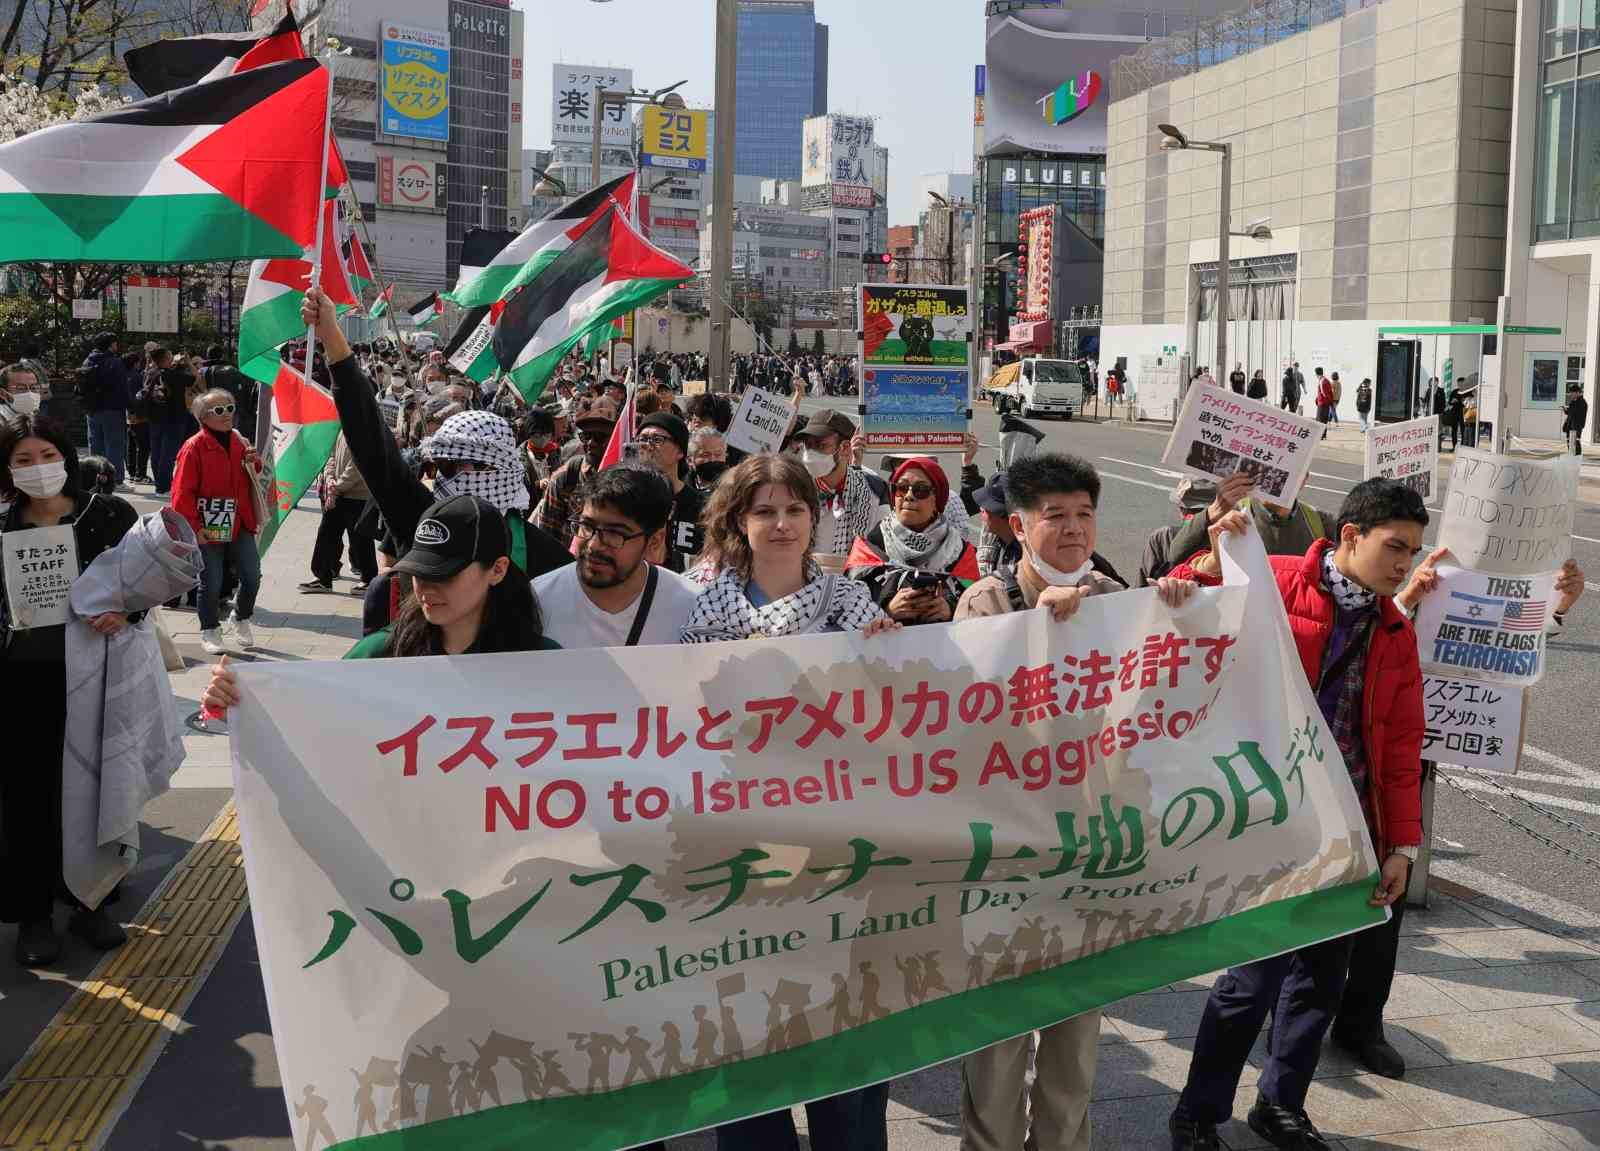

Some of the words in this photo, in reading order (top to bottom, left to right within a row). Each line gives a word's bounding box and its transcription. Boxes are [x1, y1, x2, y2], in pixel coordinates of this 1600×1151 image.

[832, 117, 873, 145] カラオケ
[836, 159, 869, 182] 鉄人
[895, 289, 937, 298] イスラエルは
[867, 297, 967, 316] ガザから撤退しろ
[745, 408, 772, 431] Land
[1199, 410, 1297, 453] 直ちにイラン攻撃を
[908, 434, 926, 443] with
[927, 433, 962, 443] Palestine
[21, 559, 65, 573] STAFF
[1486, 577, 1532, 599] THESE
[1437, 623, 1466, 642] ARE
[1468, 627, 1494, 646] THE
[1495, 631, 1537, 651] FLAGS
[376, 632, 1237, 776] イスラエルとアメリカの無法を許す
[1422, 728, 1503, 756] テロ国家
[485, 779, 587, 832] NO
[607, 781, 671, 823] to
[599, 928, 807, 1002] Palestine
[826, 896, 937, 944] Land
[955, 888, 1040, 917] Day
[1062, 864, 1200, 902] Protest
